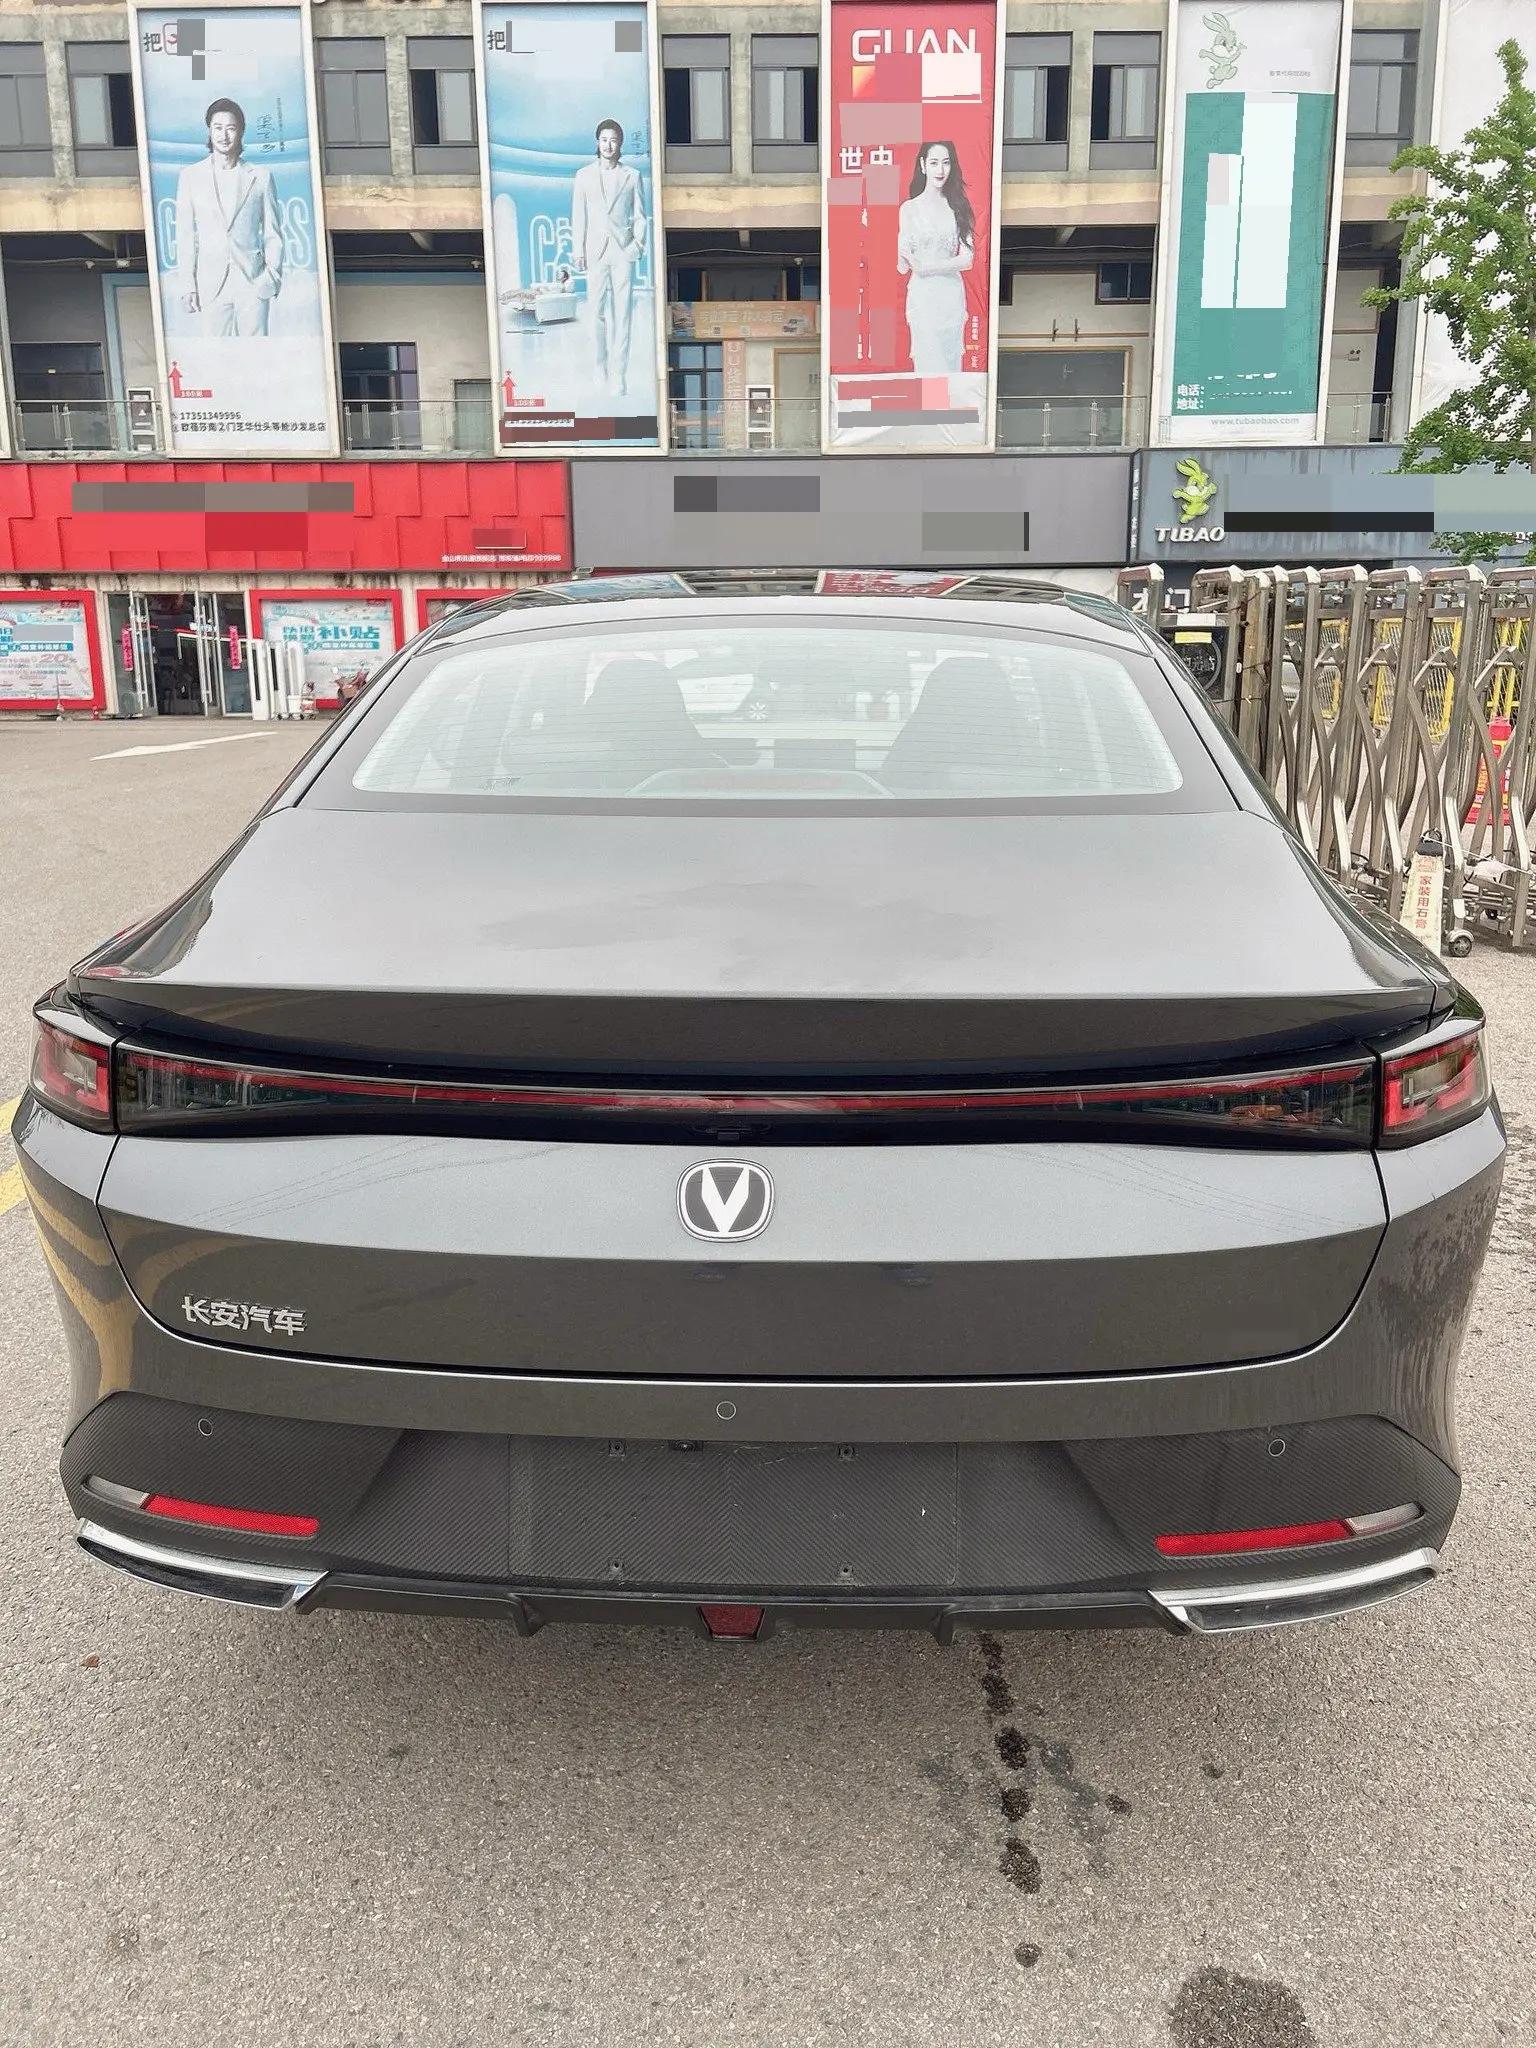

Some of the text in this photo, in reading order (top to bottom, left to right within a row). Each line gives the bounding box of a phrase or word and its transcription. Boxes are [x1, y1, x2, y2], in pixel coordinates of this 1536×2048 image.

[144, 32, 162, 52] 把
[487, 30, 505, 50] 把
[181, 1296, 306, 1336] 长安汽车
